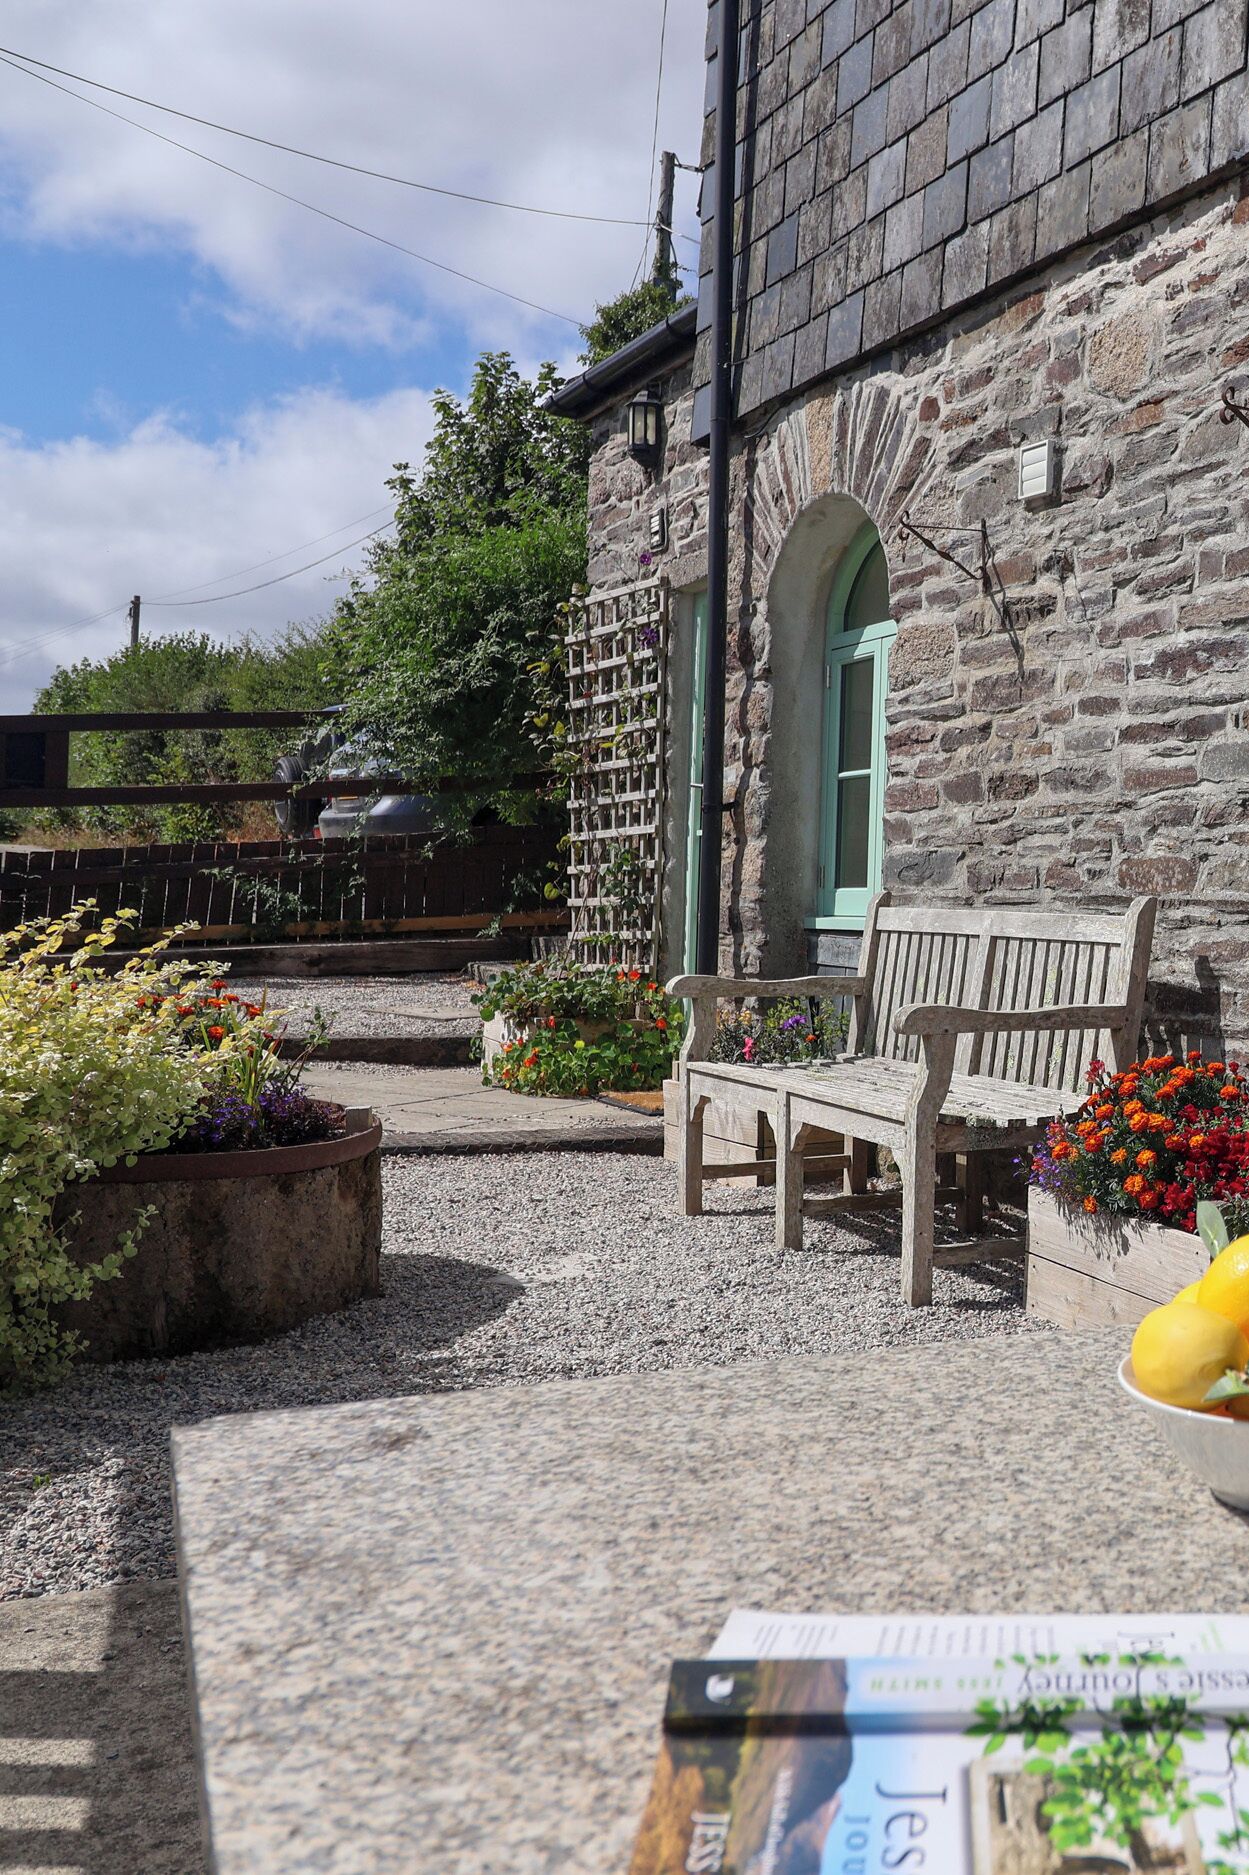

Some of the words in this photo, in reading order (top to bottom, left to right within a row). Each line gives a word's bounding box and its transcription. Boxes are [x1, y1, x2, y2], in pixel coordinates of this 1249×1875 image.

[1016, 1665, 1143, 1698] Journey
[685, 1809, 732, 1873] JESS
[875, 1782, 948, 1875] Jes
